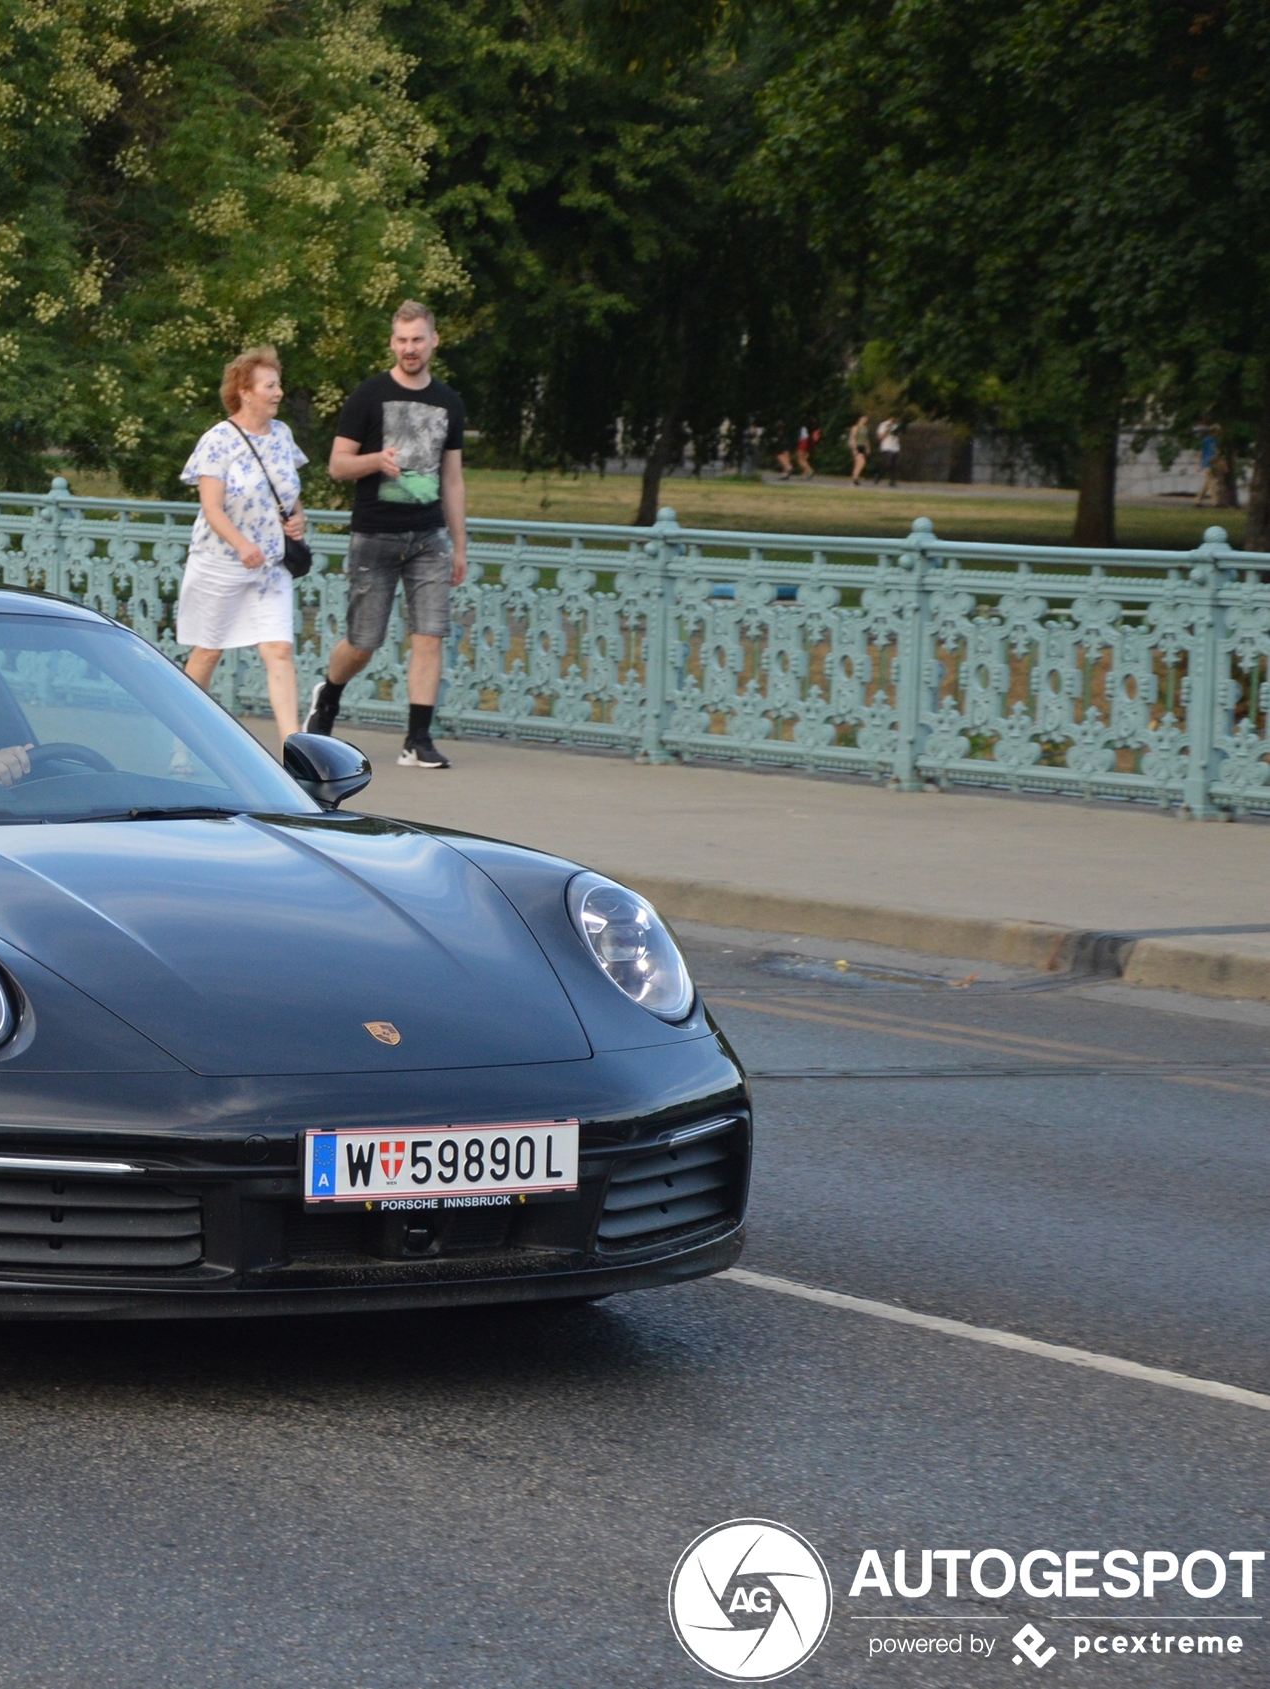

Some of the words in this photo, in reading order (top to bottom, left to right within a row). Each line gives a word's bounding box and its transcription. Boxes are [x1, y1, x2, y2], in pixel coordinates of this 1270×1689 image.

[346, 1142, 375, 1187] W
[411, 1134, 563, 1184] 59890L
[318, 1173, 329, 1187] A
[381, 1199, 439, 1211] PORSCHE
[443, 1195, 511, 1209] INNSBRUCK
